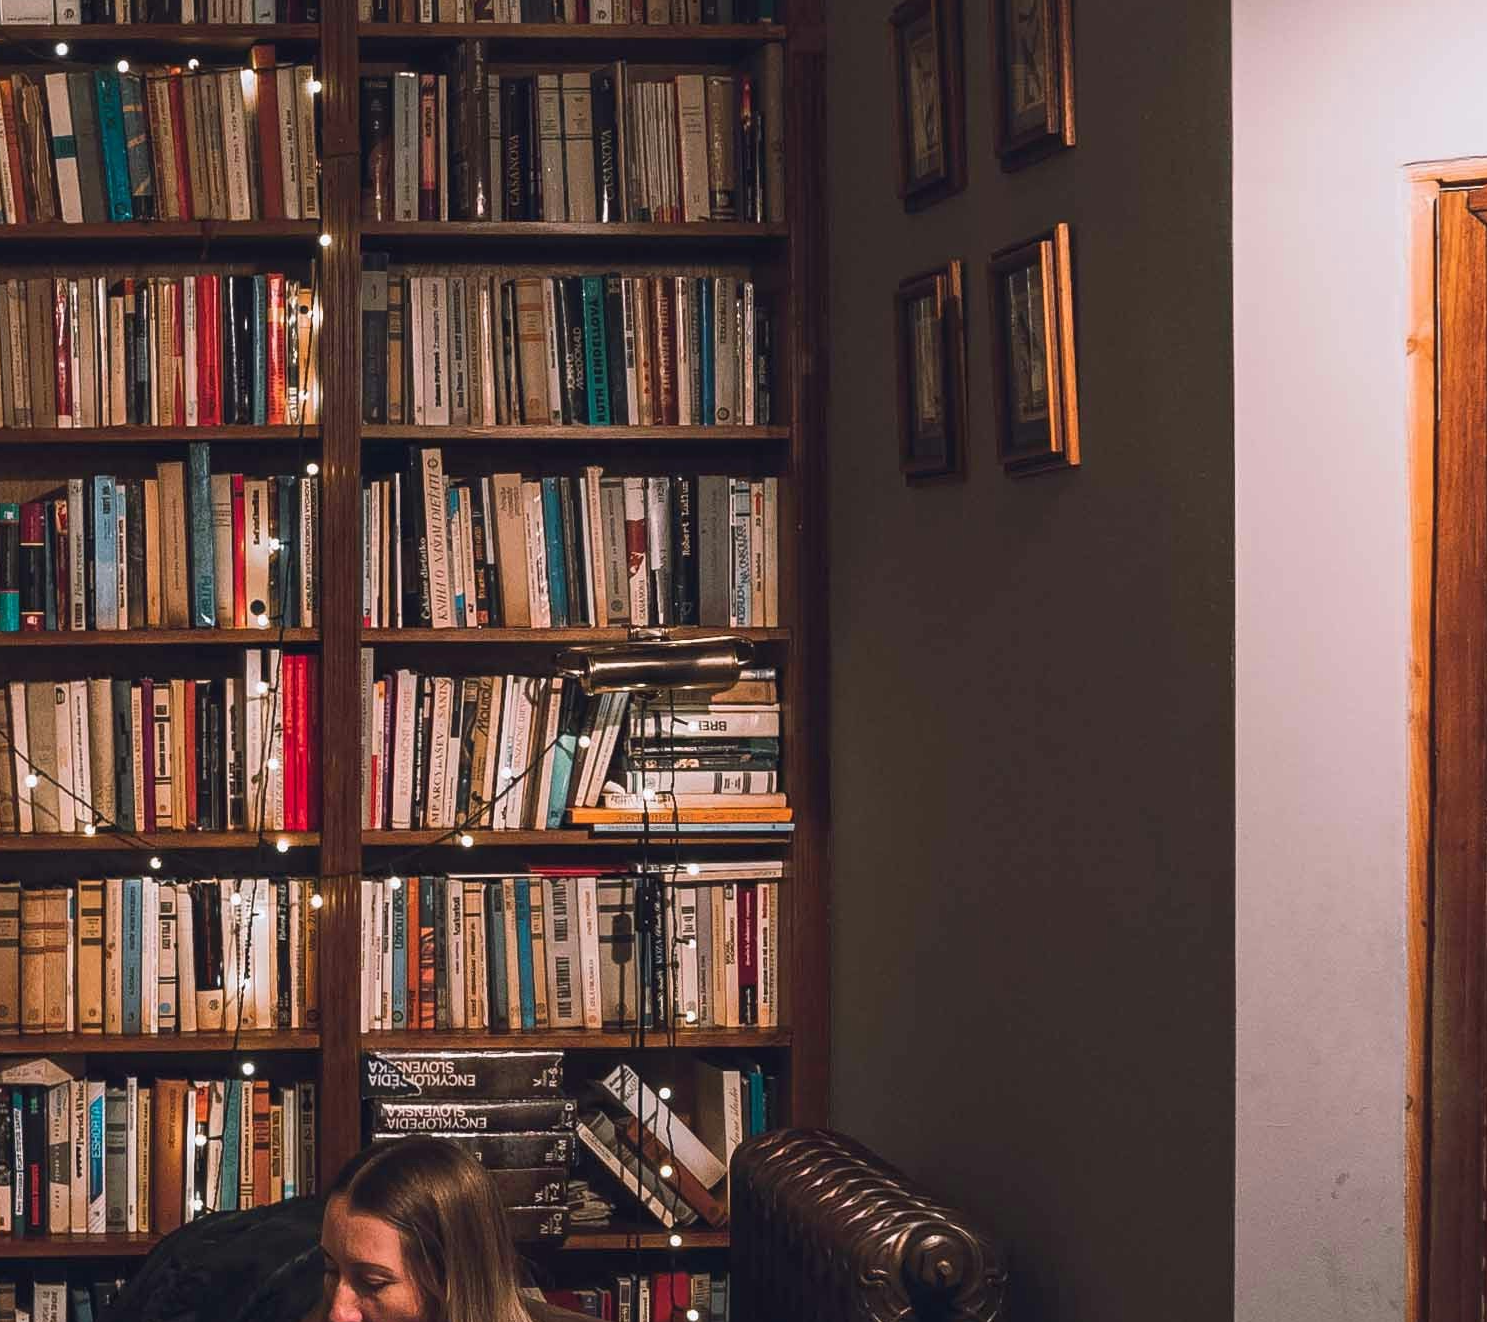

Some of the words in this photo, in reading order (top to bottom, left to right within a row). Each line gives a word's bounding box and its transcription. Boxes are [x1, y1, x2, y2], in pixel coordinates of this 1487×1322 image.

[509, 134, 521, 207] CASANOVA
[593, 387, 605, 423] RUTH
[681, 519, 691, 557] Robert
[75, 1082, 85, 1111] White
[75, 1111, 85, 1146] Patrick
[91, 1105, 101, 1158] ESKORTA
